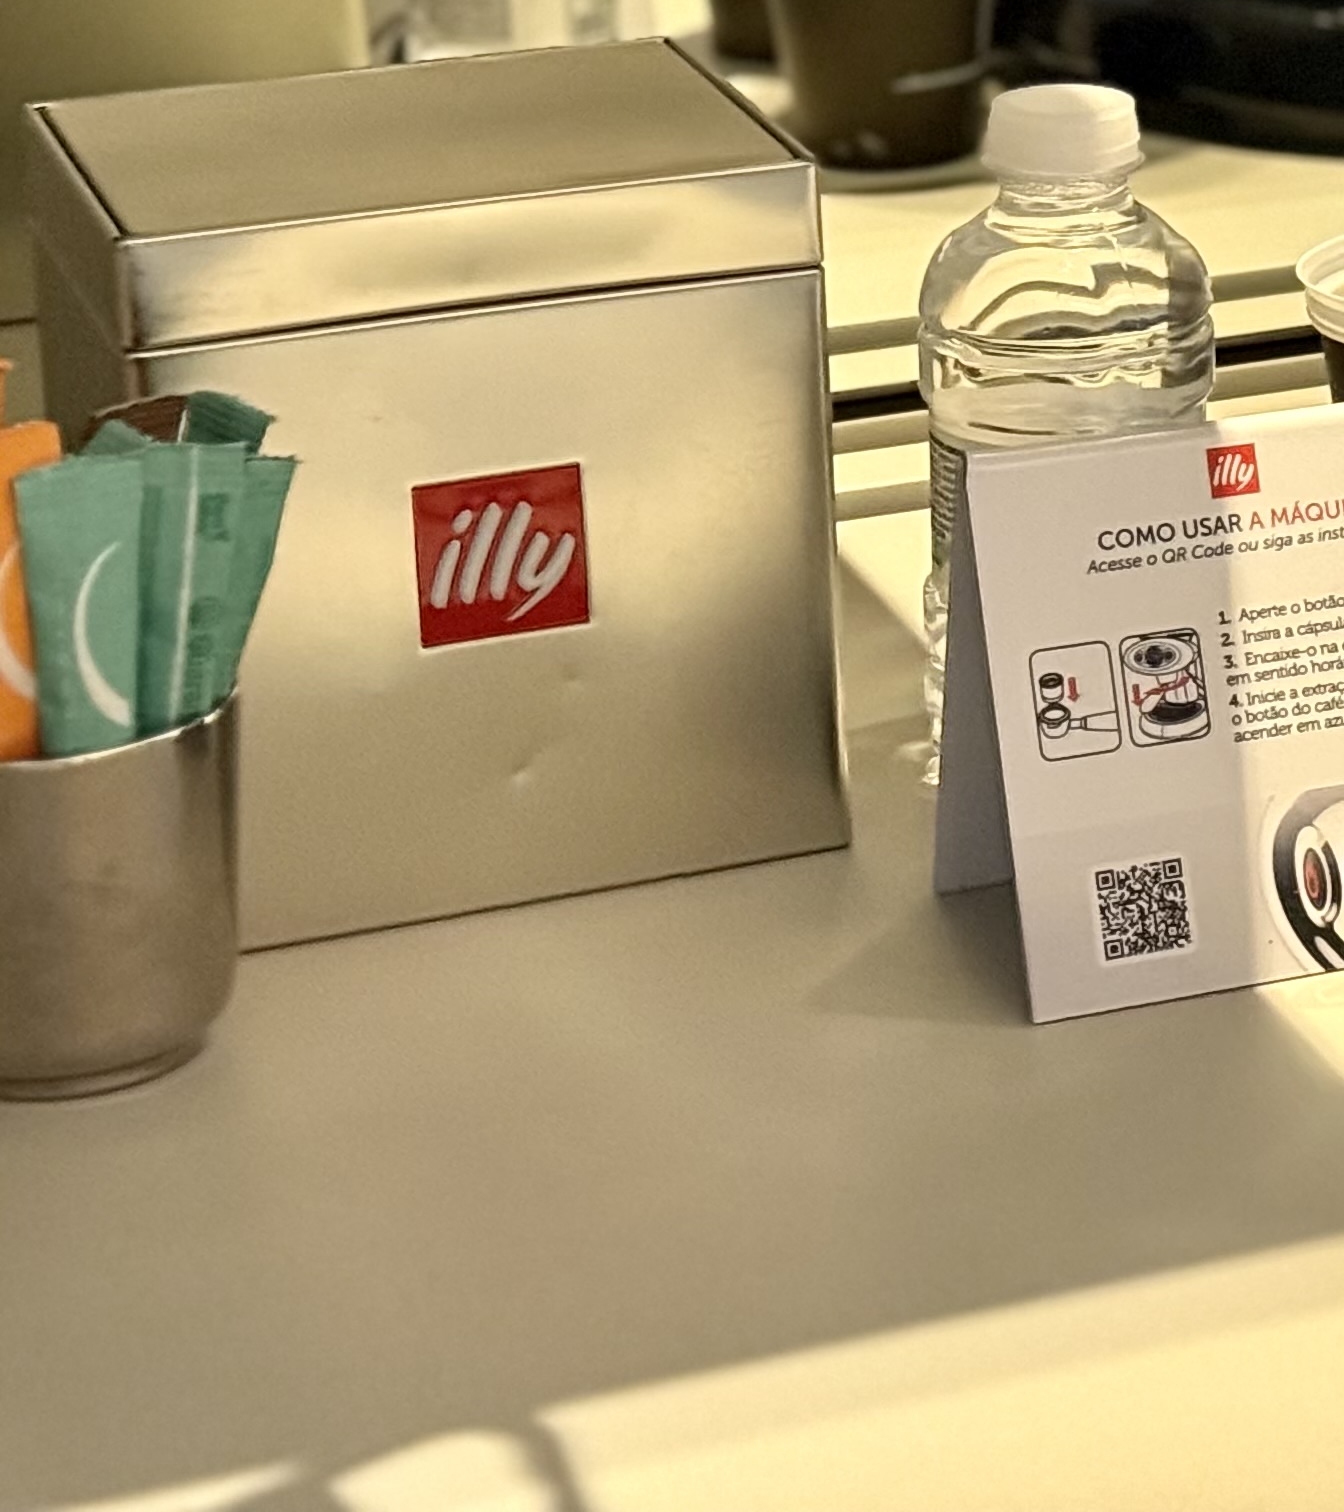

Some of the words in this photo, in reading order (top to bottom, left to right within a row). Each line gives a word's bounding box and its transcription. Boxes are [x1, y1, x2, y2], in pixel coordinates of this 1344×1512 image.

[1213, 453, 1255, 491] illy
[1098, 522, 1176, 551] COMO
[1182, 513, 1243, 539] USAR
[1248, 511, 1265, 531] A
[429, 501, 575, 622] illy
[1087, 555, 1142, 574] Acesse
[1146, 554, 1157, 566] o
[1162, 547, 1187, 564] QR
[1191, 540, 1235, 560] Code
[1238, 538, 1259, 553] ou
[1262, 532, 1293, 551] siga
[1297, 531, 1314, 545] as
[1218, 611, 1232, 625] 1.
[1239, 604, 1288, 624] Aperte
[1290, 602, 1301, 614] o
[1220, 633, 1235, 647] 2.
[1242, 626, 1282, 645] Insira
[1285, 626, 1295, 638] a
[1223, 655, 1238, 669] 3.
[1244, 644, 1317, 667] Encaixe-o
[1320, 641, 1339, 656] na
[1226, 672, 1251, 687] em
[1254, 661, 1309, 683] sentido
[1228, 693, 1243, 708] 4.
[1246, 690, 1286, 707] Inicie
[1289, 688, 1299, 700] a
[1231, 714, 1242, 726] o
[1246, 704, 1289, 724] botão
[1291, 701, 1312, 717] do
[1233, 722, 1293, 743] acender
[1296, 718, 1322, 734] em
